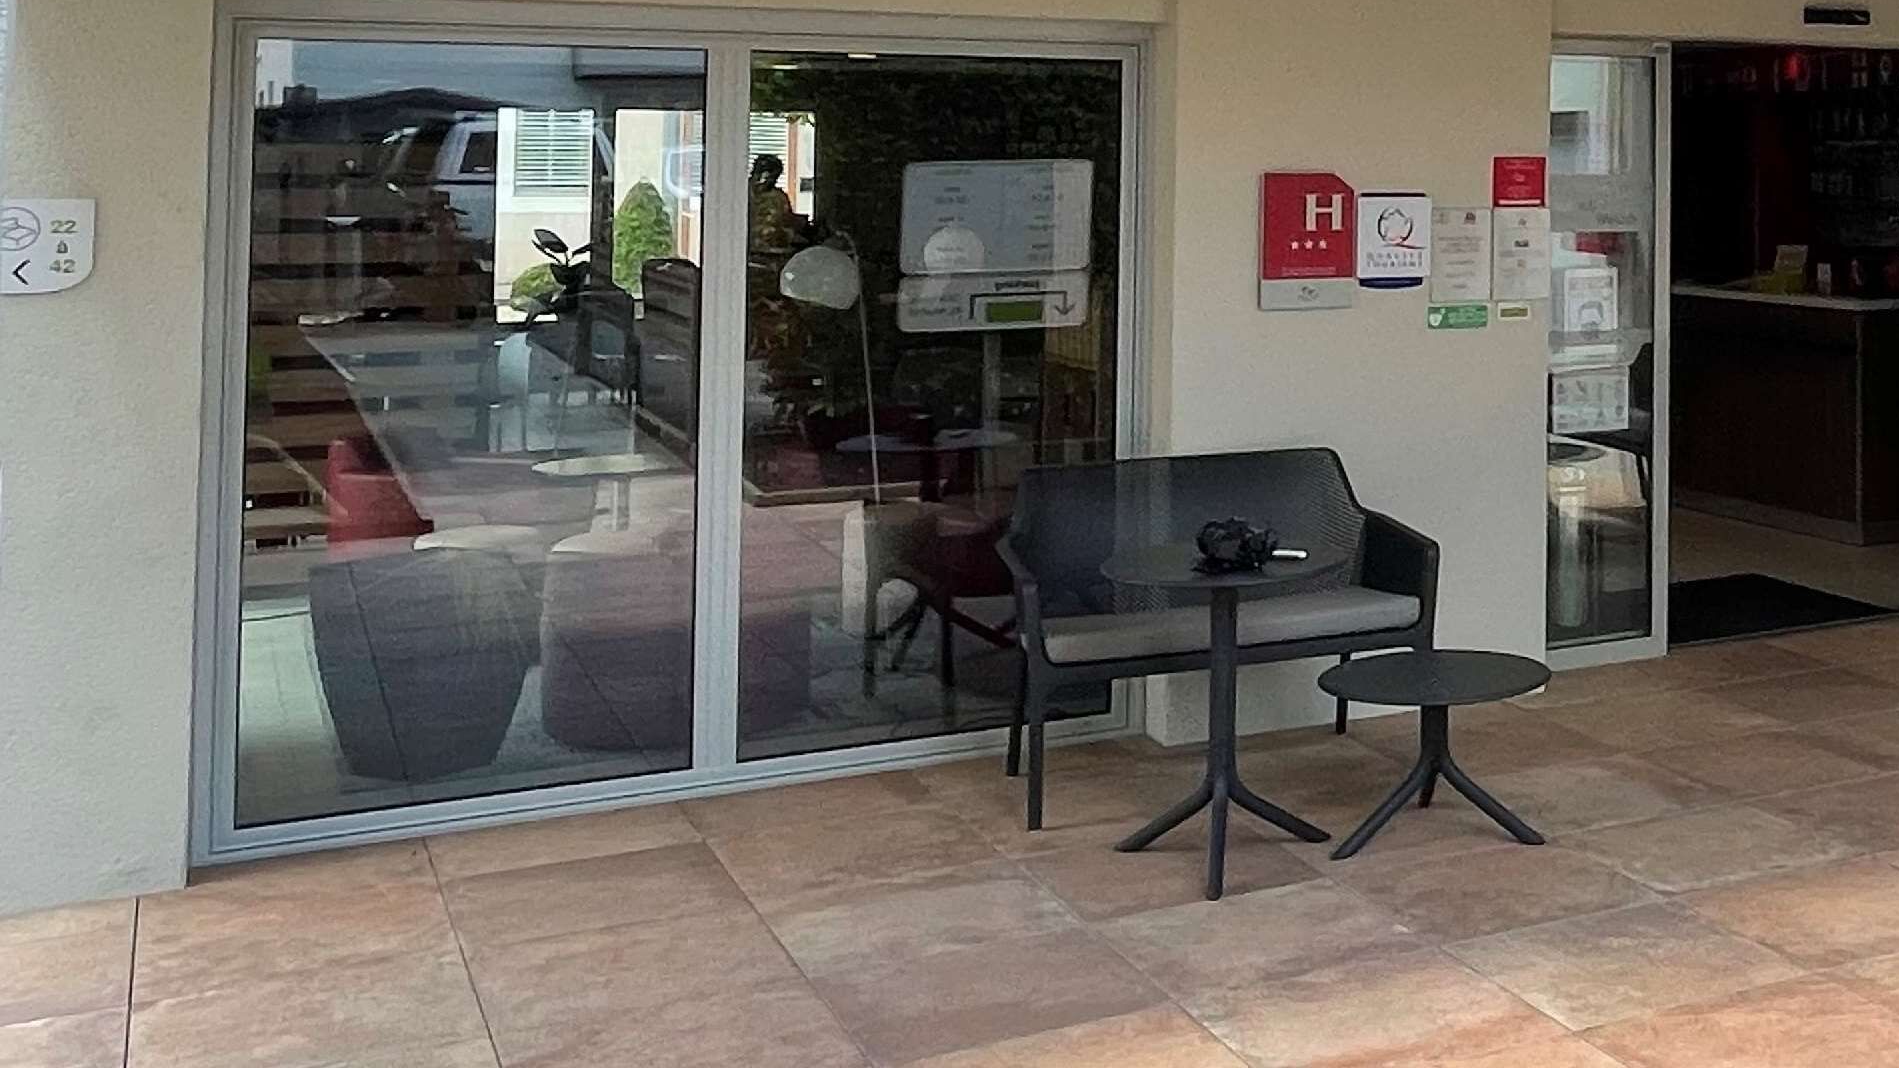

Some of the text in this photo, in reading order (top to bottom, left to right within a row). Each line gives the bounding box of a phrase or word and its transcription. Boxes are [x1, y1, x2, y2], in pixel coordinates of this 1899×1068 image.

[1305, 193, 1344, 231] H
[50, 220, 77, 234] 22
[49, 259, 76, 274] 42
